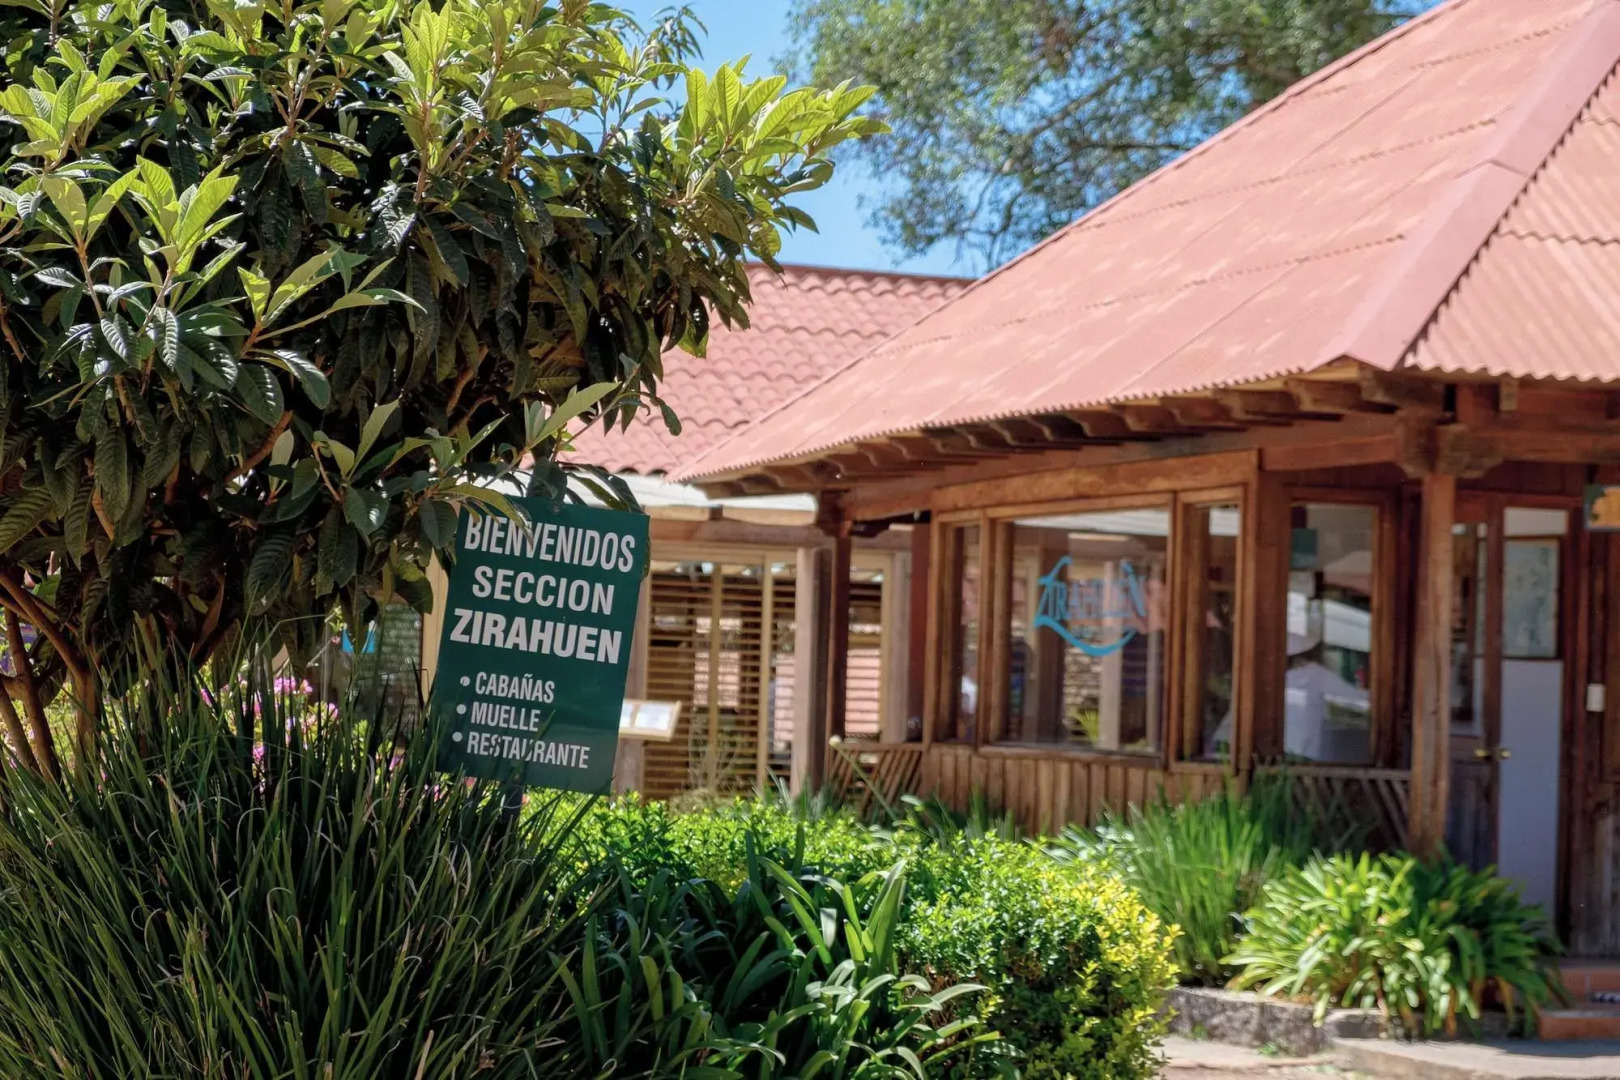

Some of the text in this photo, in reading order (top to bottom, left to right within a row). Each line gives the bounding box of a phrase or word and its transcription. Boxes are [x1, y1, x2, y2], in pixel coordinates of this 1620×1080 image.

[464, 512, 636, 573] BIENVENIDOS
[471, 566, 615, 615] SECCION
[449, 608, 622, 664] ZIRAHUEN
[475, 672, 555, 704] CABAÑAS
[470, 702, 541, 732] MUELLE
[467, 732, 591, 769] RESTAURANTE
